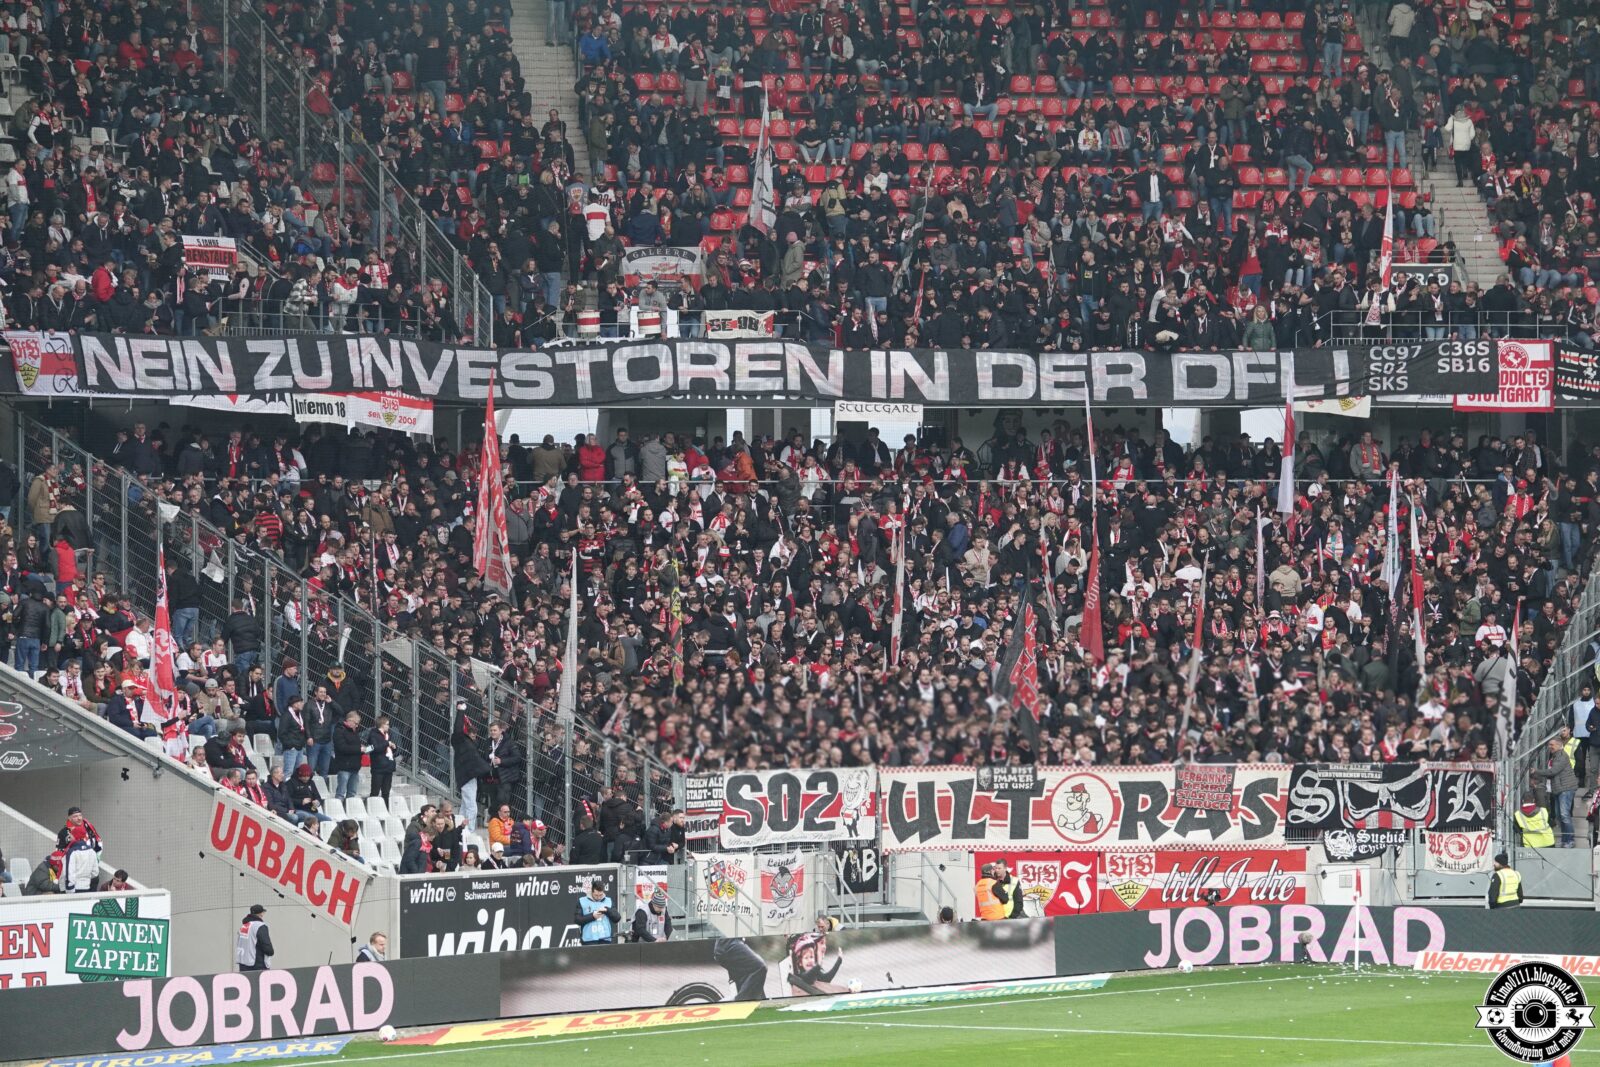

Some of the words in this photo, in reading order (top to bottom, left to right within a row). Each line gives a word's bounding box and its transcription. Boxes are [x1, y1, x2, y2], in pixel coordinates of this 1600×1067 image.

[632, 247, 688, 260] GALEERE
[1369, 345, 1421, 360] CC97
[1438, 341, 1490, 356] C36S
[80, 335, 236, 391] NEIN
[246, 338, 333, 389] ZU
[346, 337, 844, 400] INVESTOREN
[870, 350, 950, 401] IN
[976, 350, 1149, 401] DER
[1171, 349, 1349, 400] DFL!
[1437, 357, 1490, 373] SB16
[1368, 376, 1408, 391] SKS
[1500, 370, 1547, 386] DDICTS
[295, 398, 333, 416] Inferno
[335, 401, 346, 418] 18
[398, 415, 417, 425] 2008
[993, 774, 1034, 783] IMMER
[210, 801, 361, 925] URBACH
[410, 882, 445, 904] wiha
[472, 881, 490, 890] Made
[492, 880, 500, 889] im
[516, 876, 549, 897] wiha
[1250, 858, 1296, 902] die
[464, 890, 507, 901] Schwarzwald
[72, 920, 165, 945] TANNEN
[428, 908, 552, 957] wiha
[1143, 904, 1446, 968] JOBRAD
[74, 943, 160, 972] ZÄPFLE
[1421, 952, 1521, 972] WeberHa
[115, 963, 394, 1051] JOBRAD
[565, 1007, 720, 1028] LOTTO
[228, 1040, 343, 1059] PARK
